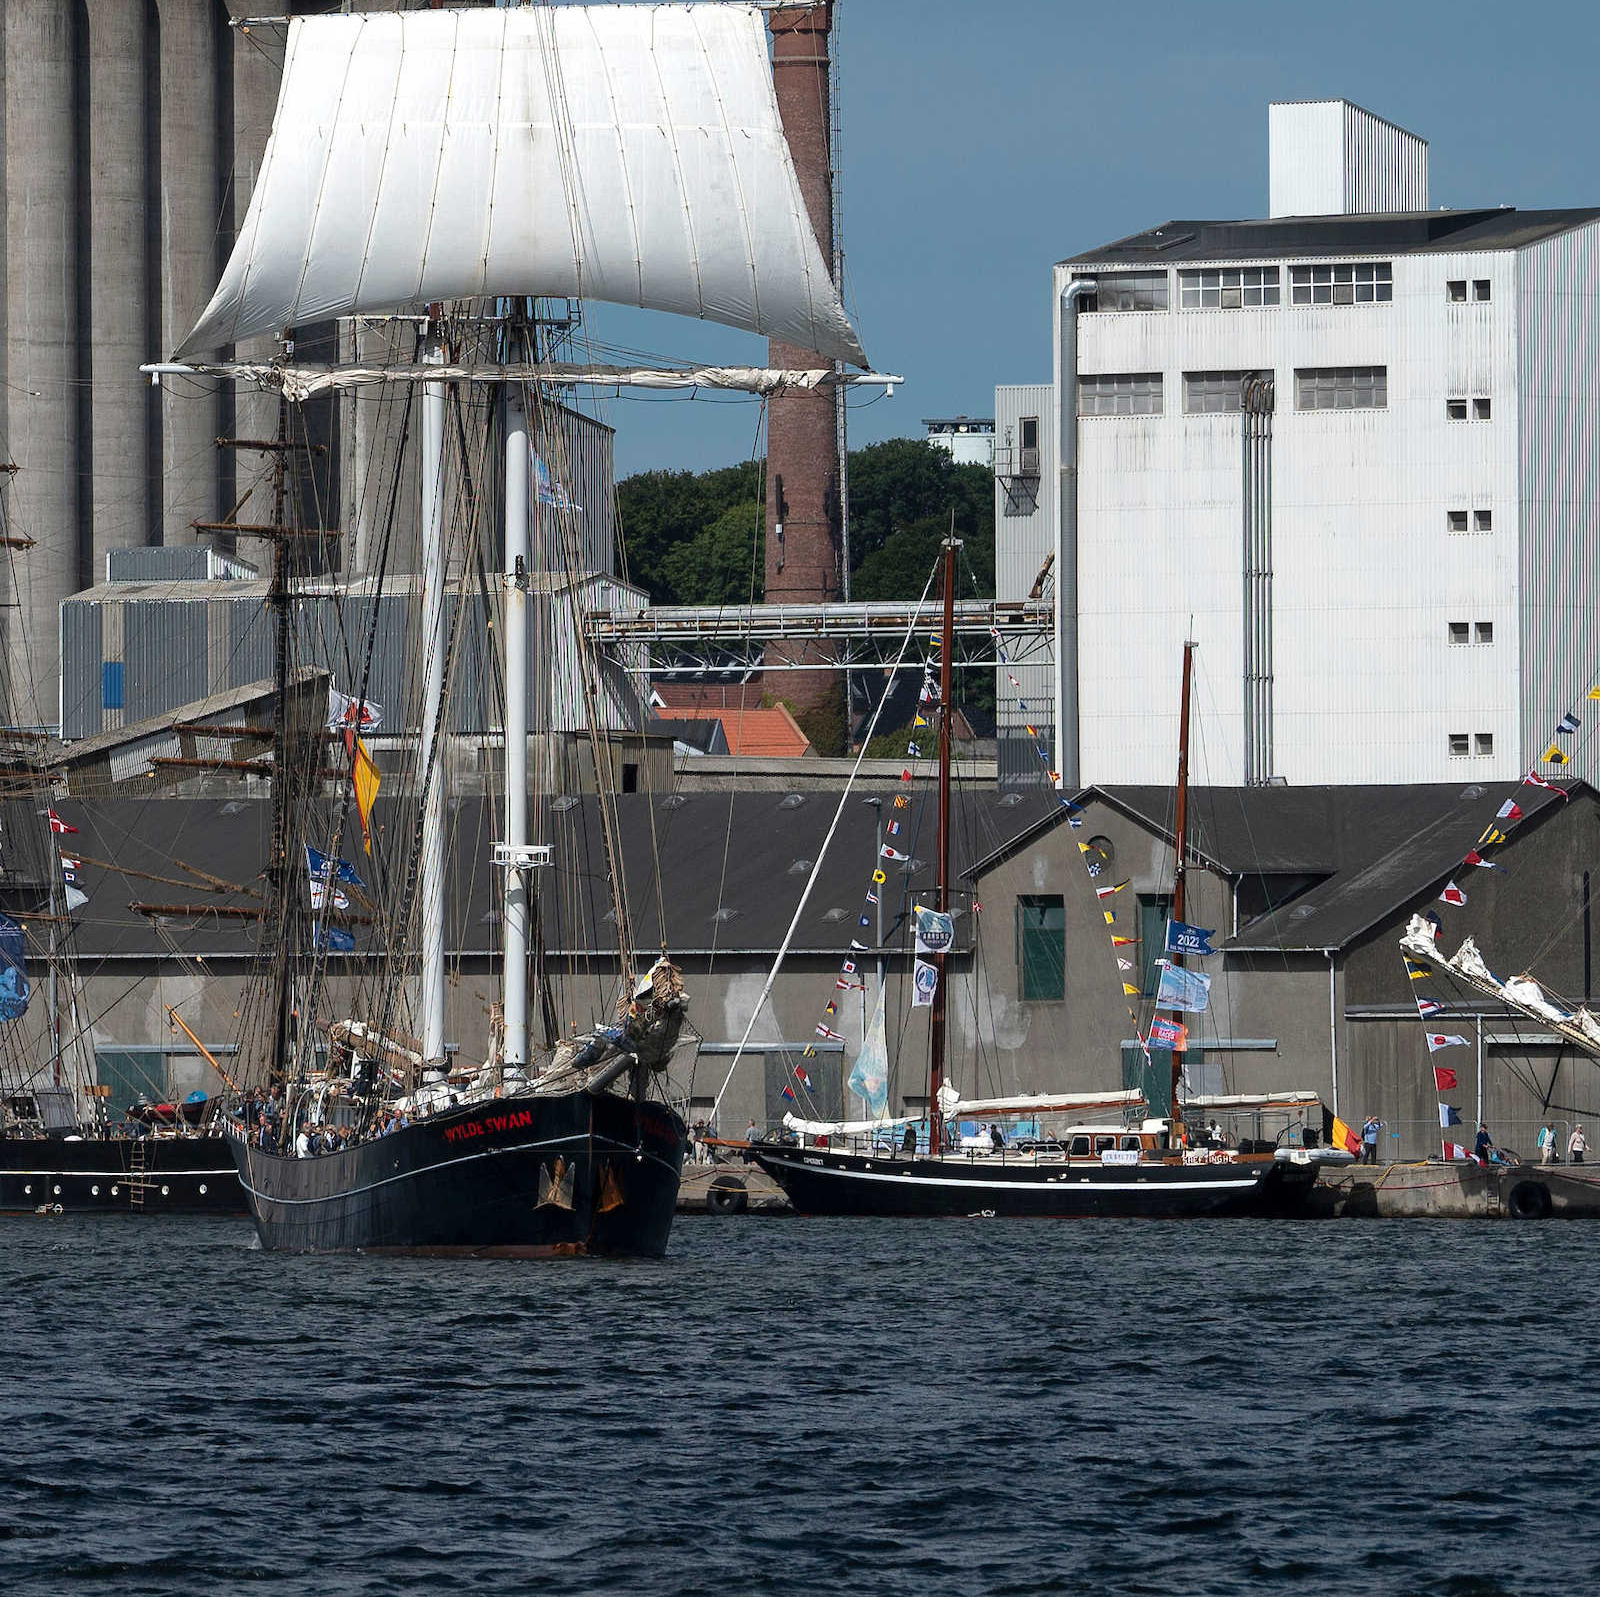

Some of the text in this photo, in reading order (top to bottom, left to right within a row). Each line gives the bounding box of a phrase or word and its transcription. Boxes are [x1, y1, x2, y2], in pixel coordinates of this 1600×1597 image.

[1177, 934, 1200, 947] 2022
[444, 1110, 532, 1143] WYLDE SWAN
